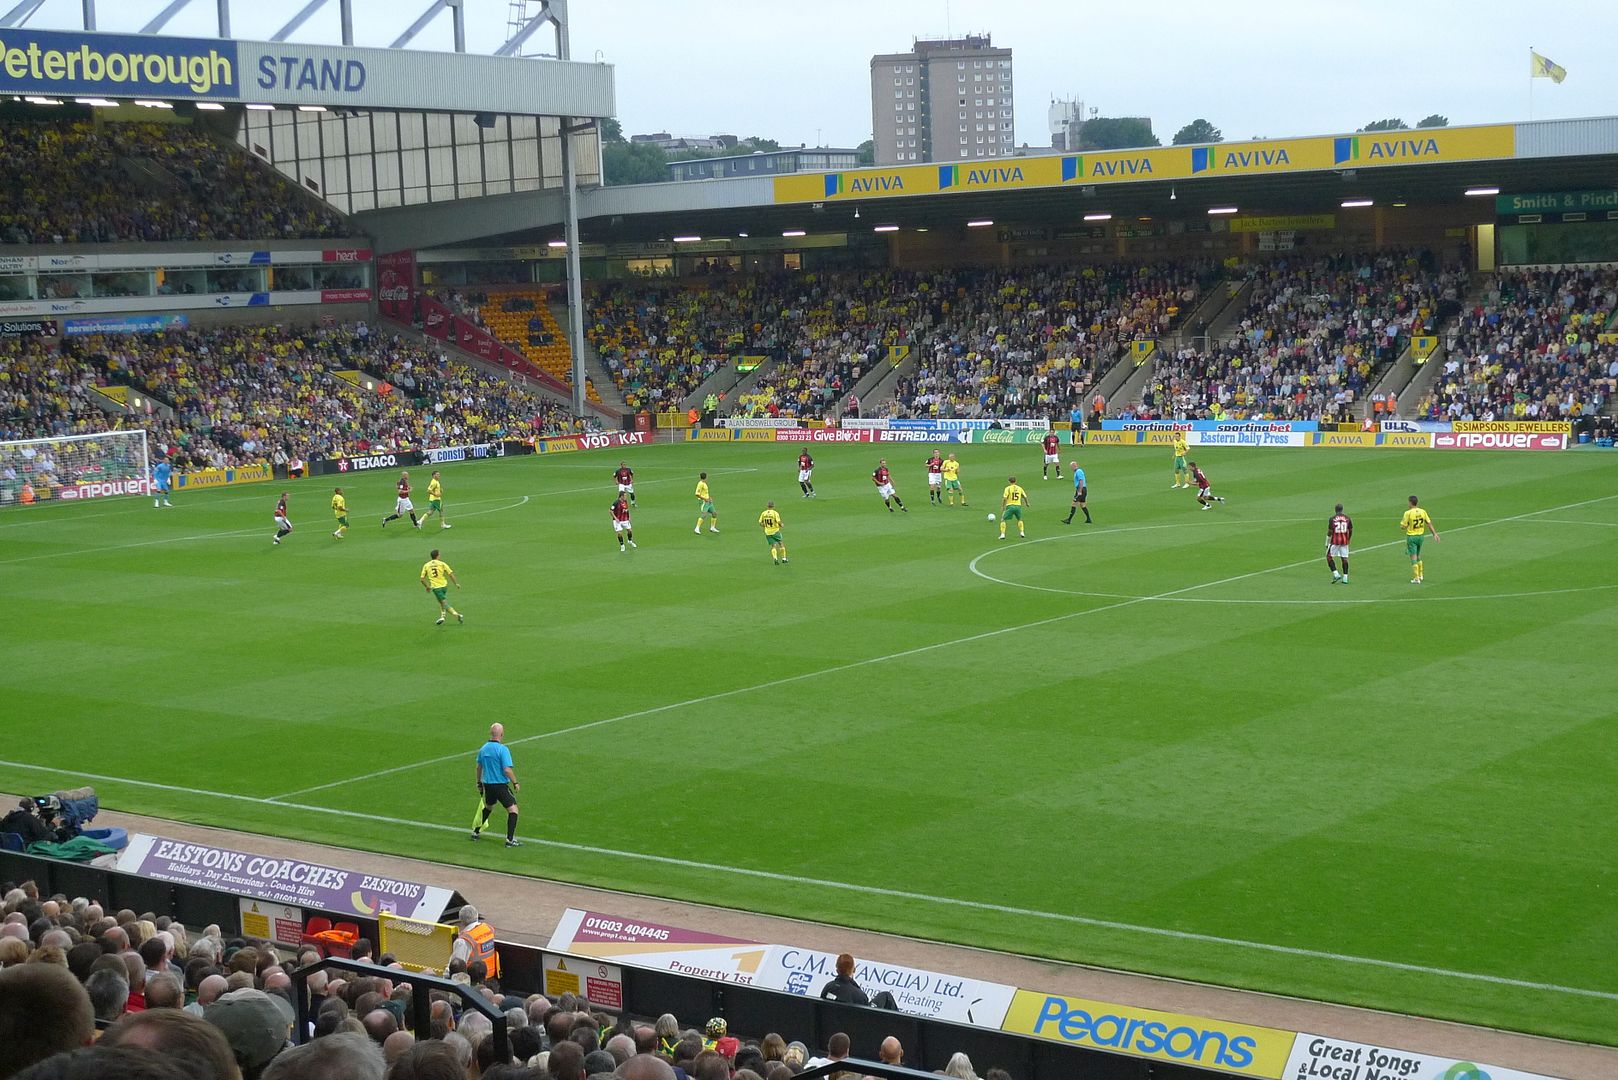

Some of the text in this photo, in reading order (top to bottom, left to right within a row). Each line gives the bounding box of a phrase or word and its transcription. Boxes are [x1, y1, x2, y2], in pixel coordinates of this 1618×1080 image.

[257, 54, 365, 92] STAND
[1369, 139, 1440, 159] AVIVA
[1224, 149, 1290, 168] AVIVA
[1091, 158, 1153, 177] AVIVA
[967, 167, 1024, 185] AVIVA
[851, 175, 904, 193] AVIVA
[1513, 195, 1557, 209] Smith
[1563, 194, 1575, 207] &
[336, 249, 358, 261] heart
[4, 322, 42, 332] Solutions
[728, 419, 796, 427] ALAN BOSWELL GROUP
[940, 421, 994, 430] DOLPHI
[1123, 423, 1193, 431] sportingbet
[1217, 423, 1292, 432] sportingbet
[1463, 422, 1570, 432] SIMPSONS JEWELLERS
[814, 429, 835, 441] Give
[880, 430, 950, 442] BETFRED.COM
[1092, 434, 1122, 442] AVIVA
[1151, 434, 1175, 442] AVIV
[1200, 431, 1289, 446] Eastern Daily Press
[1328, 435, 1363, 444] AVIVA
[1391, 436, 1426, 445] AVIVA
[1456, 433, 1538, 447] npower
[552, 443, 575, 451] AVIVA
[193, 475, 221, 485] AVIVA
[240, 471, 269, 480] AVIVA
[79, 480, 147, 498] npower
[1012, 492, 1019, 501] 15
[764, 519, 773, 528] 14
[1334, 522, 1347, 533] 20
[1413, 518, 1424, 529] 22
[431, 568, 438, 577] 3
[154, 841, 349, 890] EASTONS COACHES
[168, 863, 201, 876] Holidays
[205, 870, 222, 881] Day
[222, 873, 265, 888] Excursions
[270, 880, 296, 893] Coach
[297, 885, 316, 897] Hire
[360, 876, 420, 898] EASTONS
[582, 927, 637, 943] www.prop1.co.uk
[585, 917, 670, 940] 01603 404445
[669, 960, 753, 985] Property 1st
[781, 950, 839, 978] C.M.
[934, 978, 965, 999] Ltd.
[898, 992, 943, 1012] Heating
[1033, 997, 1256, 1067] Pearsons
[1309, 1039, 1421, 1076] Great Songs
[1298, 1062, 1308, 1073] &
[1308, 1058, 1361, 1080] Local
